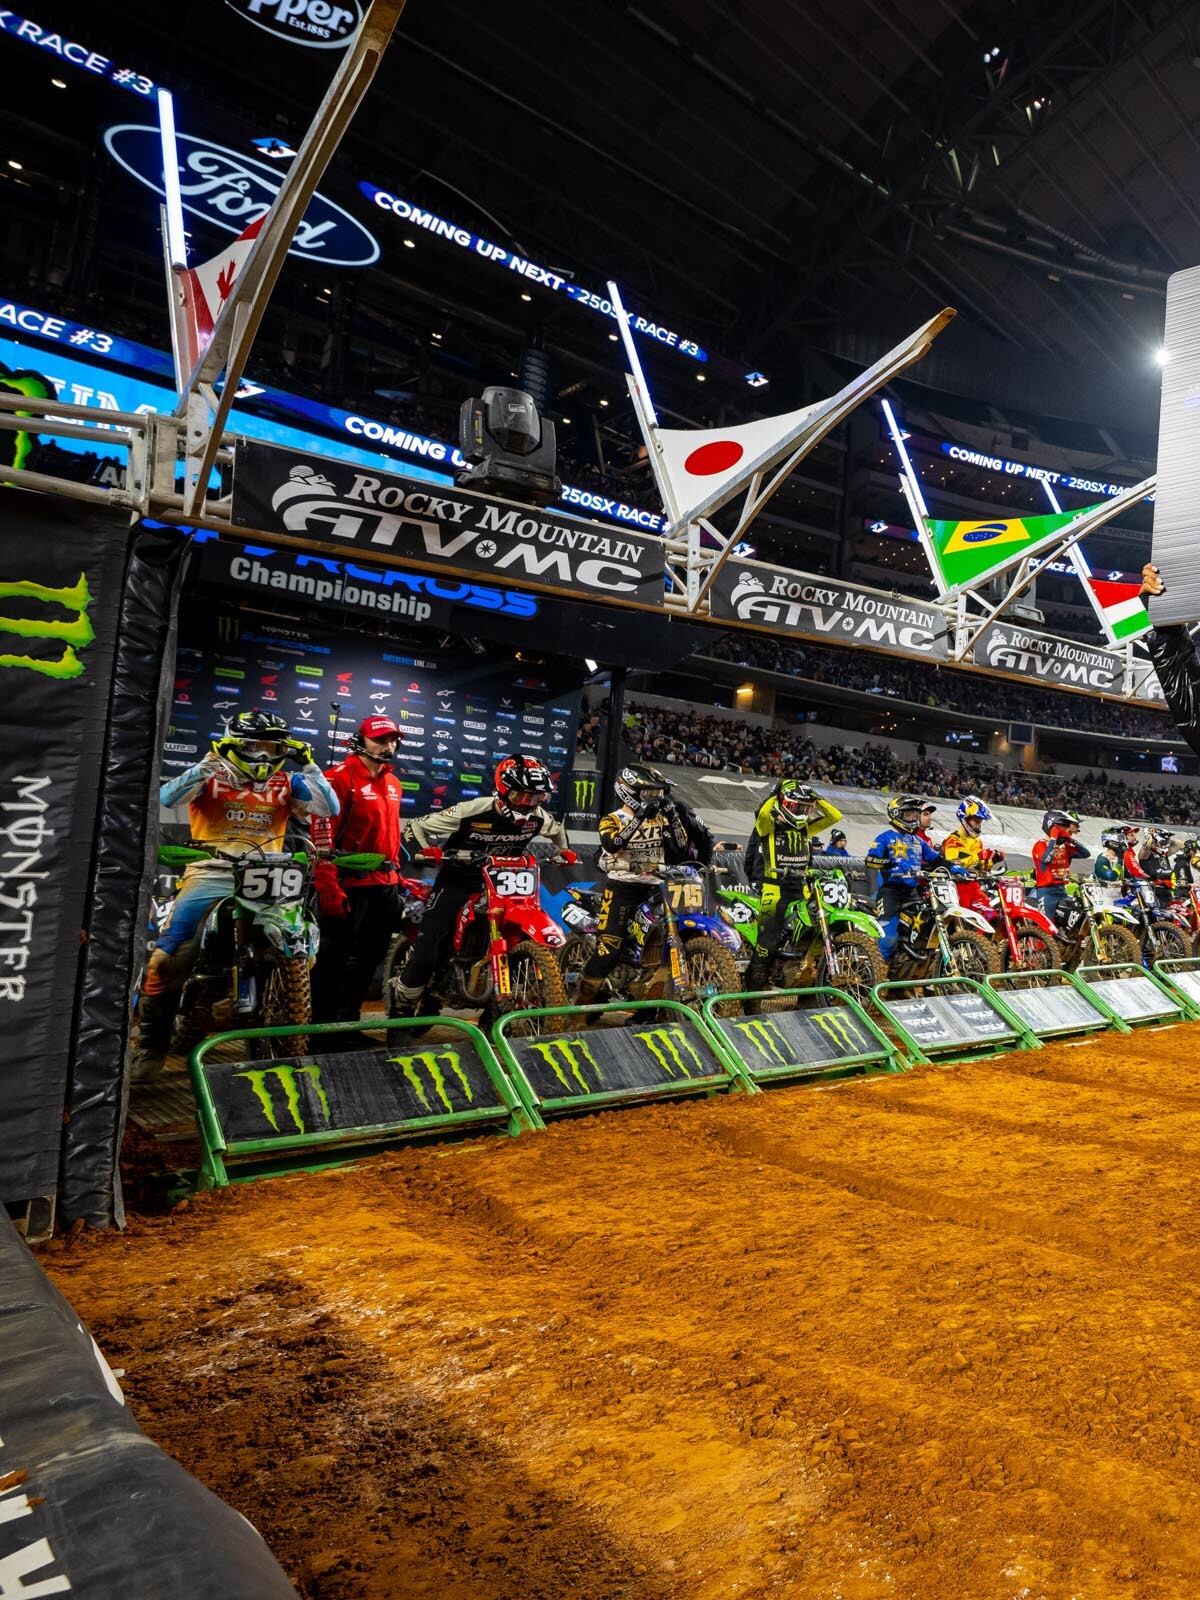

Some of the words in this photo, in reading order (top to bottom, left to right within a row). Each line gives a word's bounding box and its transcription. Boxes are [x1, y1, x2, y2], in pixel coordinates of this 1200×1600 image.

[17, 18, 110, 75] RACE
[112, 68, 155, 96] #3
[373, 191, 472, 248] COMING
[475, 238, 508, 262] UP
[509, 255, 566, 291] NEXT
[635, 316, 678, 347] RACE
[679, 338, 700, 357] #3
[69, 328, 114, 354] #3
[344, 415, 447, 462] COMING
[451, 452, 474, 470] U
[561, 484, 615, 515] 250SX
[617, 503, 662, 531] RACE
[949, 445, 1003, 471] COMING
[1005, 461, 1025, 475] UP
[1025, 466, 1061, 484] NEXT
[1068, 476, 1107, 493] 250SX
[344, 473, 474, 524] ROCKY
[476, 504, 645, 564] MOUNTAIN
[230, 556, 432, 622] Championship
[769, 575, 840, 606] ROCKY
[841, 591, 935, 629] MOUNTAIN
[1009, 631, 1053, 656] ROCKY
[1055, 642, 1115, 670] MOUNTAIN
[0, 775, 54, 1002] MONSTER
[242, 867, 304, 899] 519
[497, 871, 535, 896] 39
[668, 883, 703, 908] 715
[823, 882, 848, 905] 33
